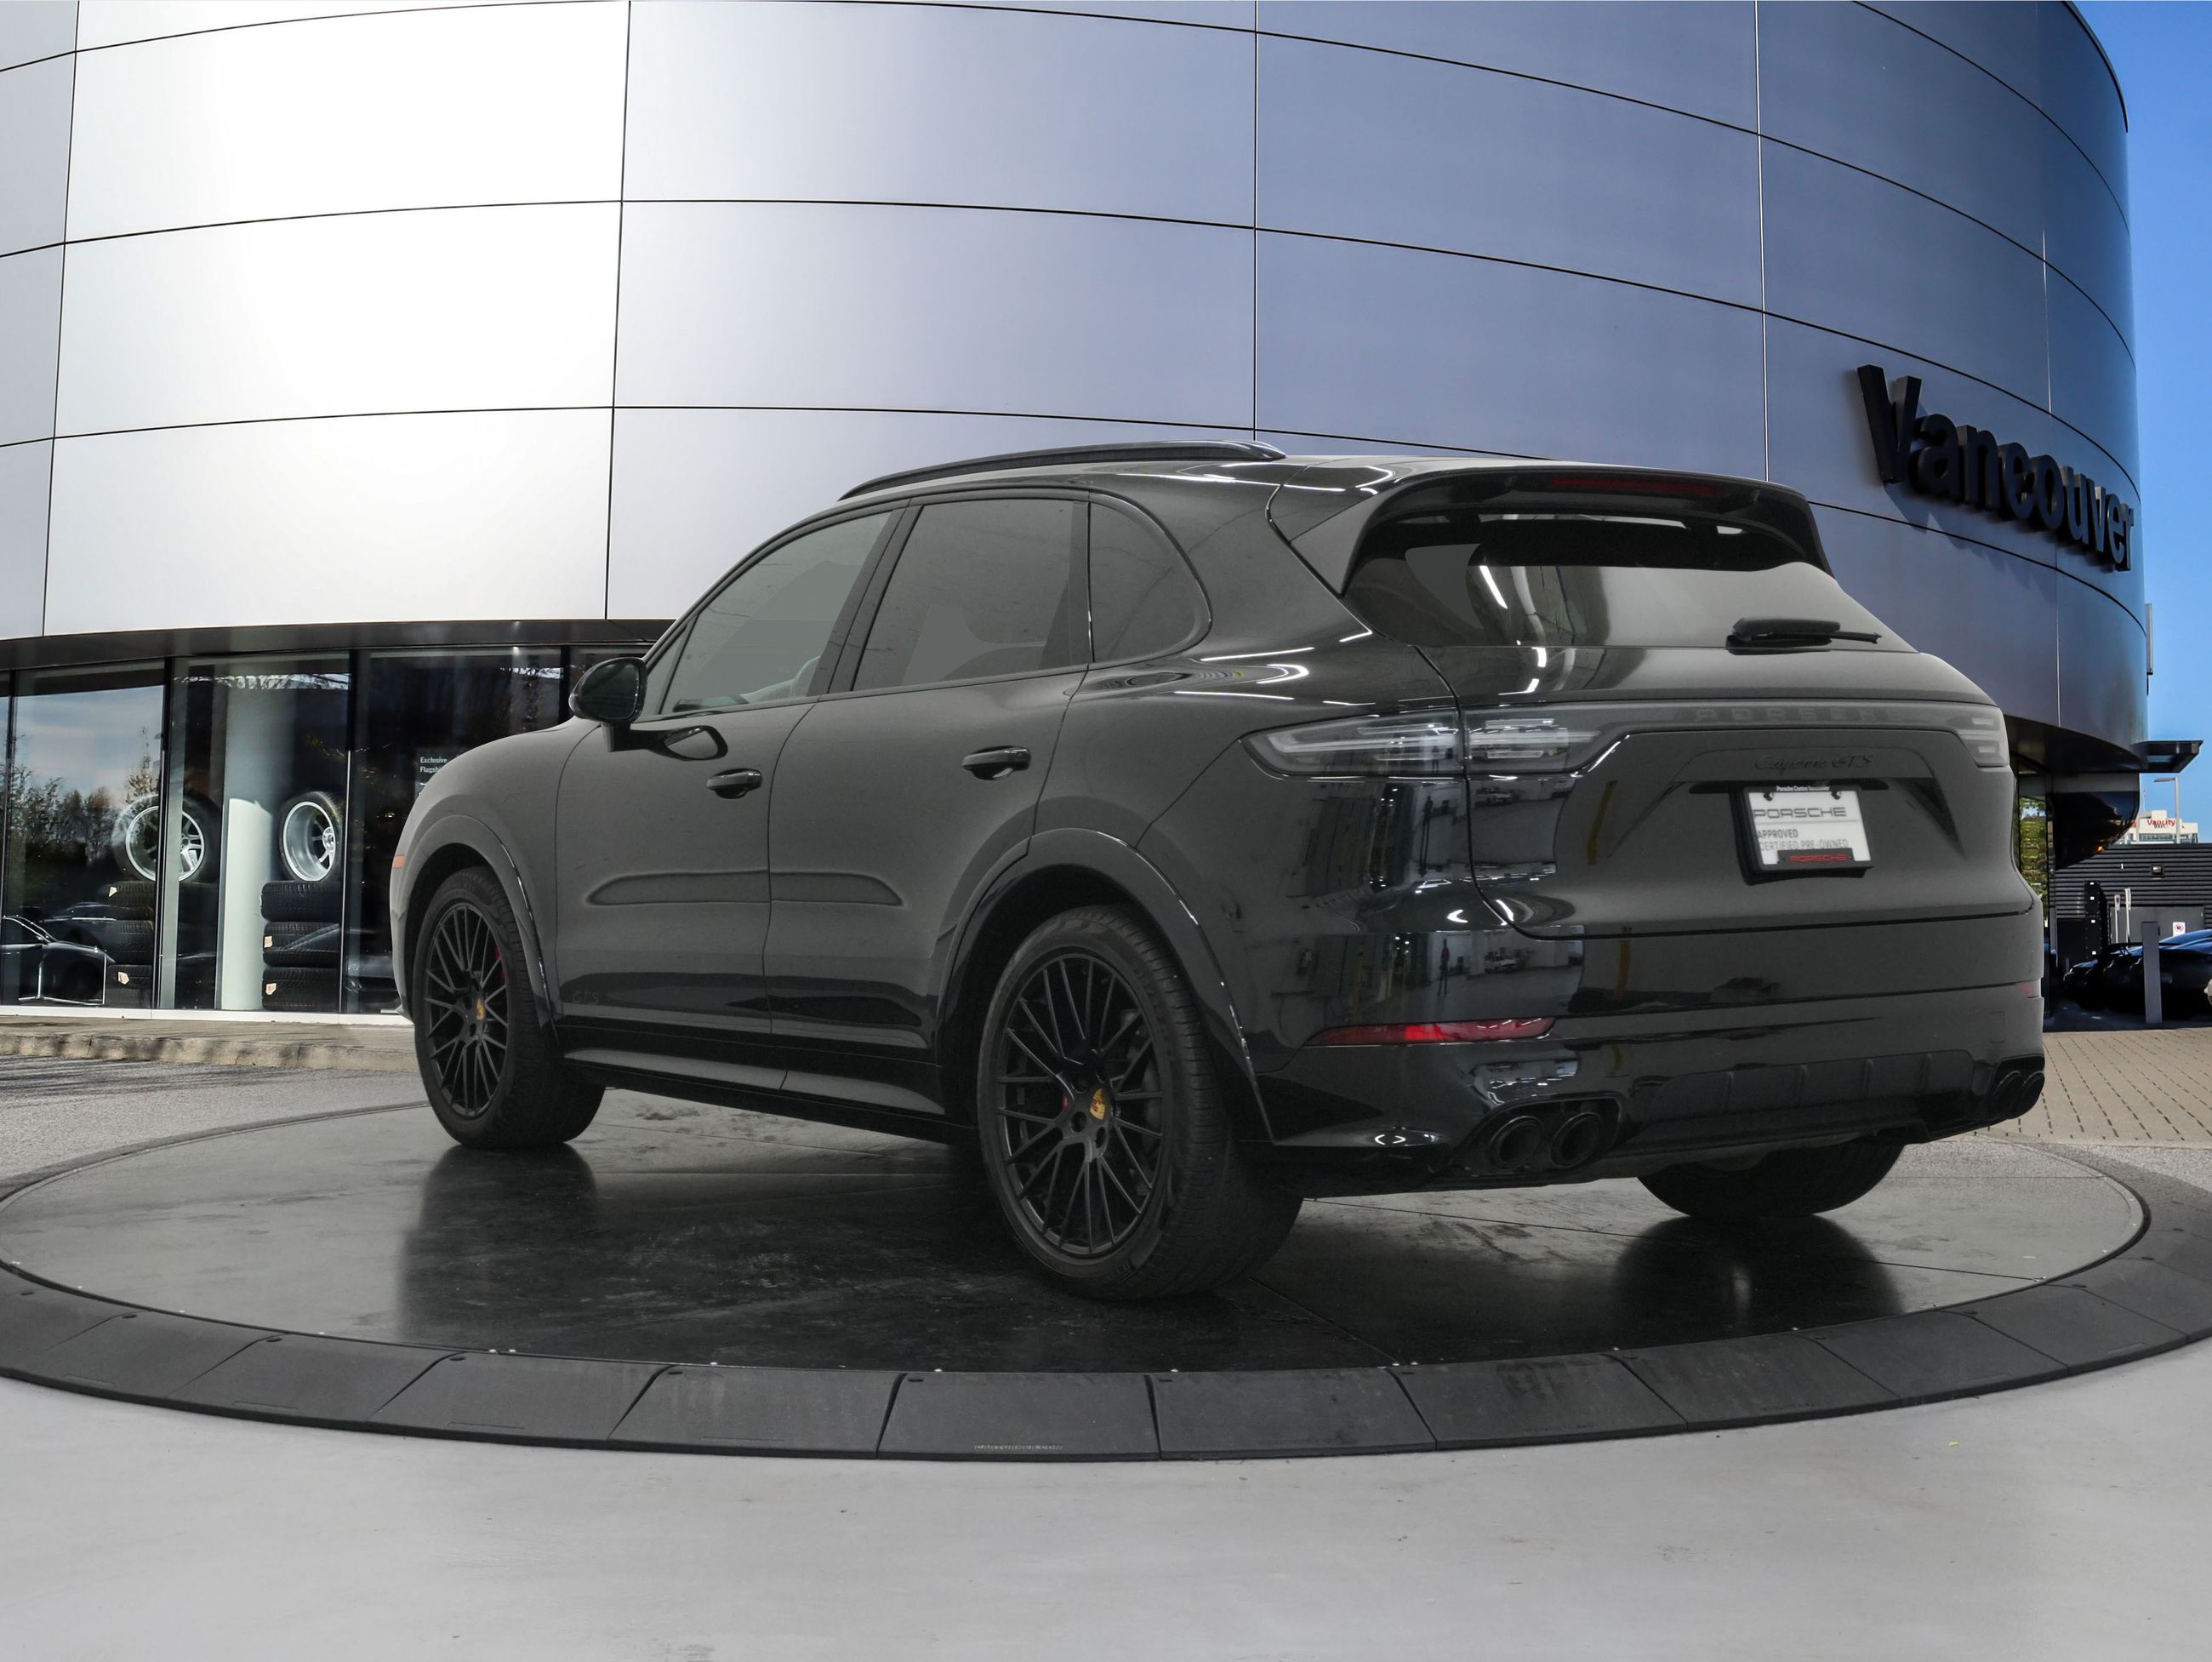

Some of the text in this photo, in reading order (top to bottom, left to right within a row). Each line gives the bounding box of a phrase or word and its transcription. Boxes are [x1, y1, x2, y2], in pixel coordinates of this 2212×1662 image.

[1857, 364, 2134, 571] Vancouver
[1695, 707, 1902, 722] PORSCHE
[1831, 754, 1874, 768] GTS
[1753, 808, 1848, 819] PORSCHE
[1757, 829, 1799, 839] APPROVED
[1759, 838, 1849, 851] CERTIFIED PRE-OWNED
[572, 991, 600, 1005] GTS
